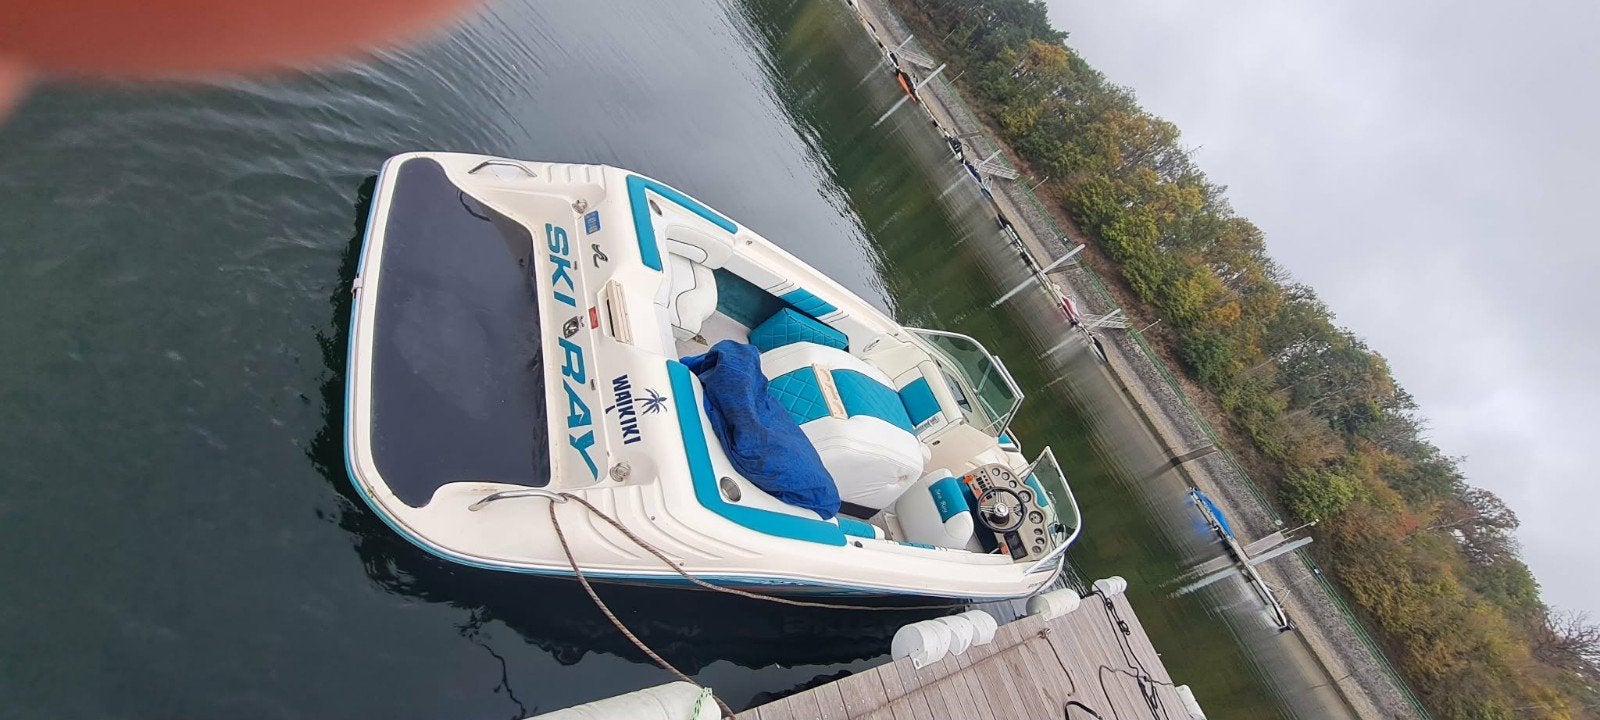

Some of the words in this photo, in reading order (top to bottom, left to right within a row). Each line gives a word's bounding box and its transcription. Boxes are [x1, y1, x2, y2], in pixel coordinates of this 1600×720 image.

[545, 223, 576, 307] SKI
[558, 337, 598, 481] RAY
[612, 374, 641, 445] WAIKIKI
